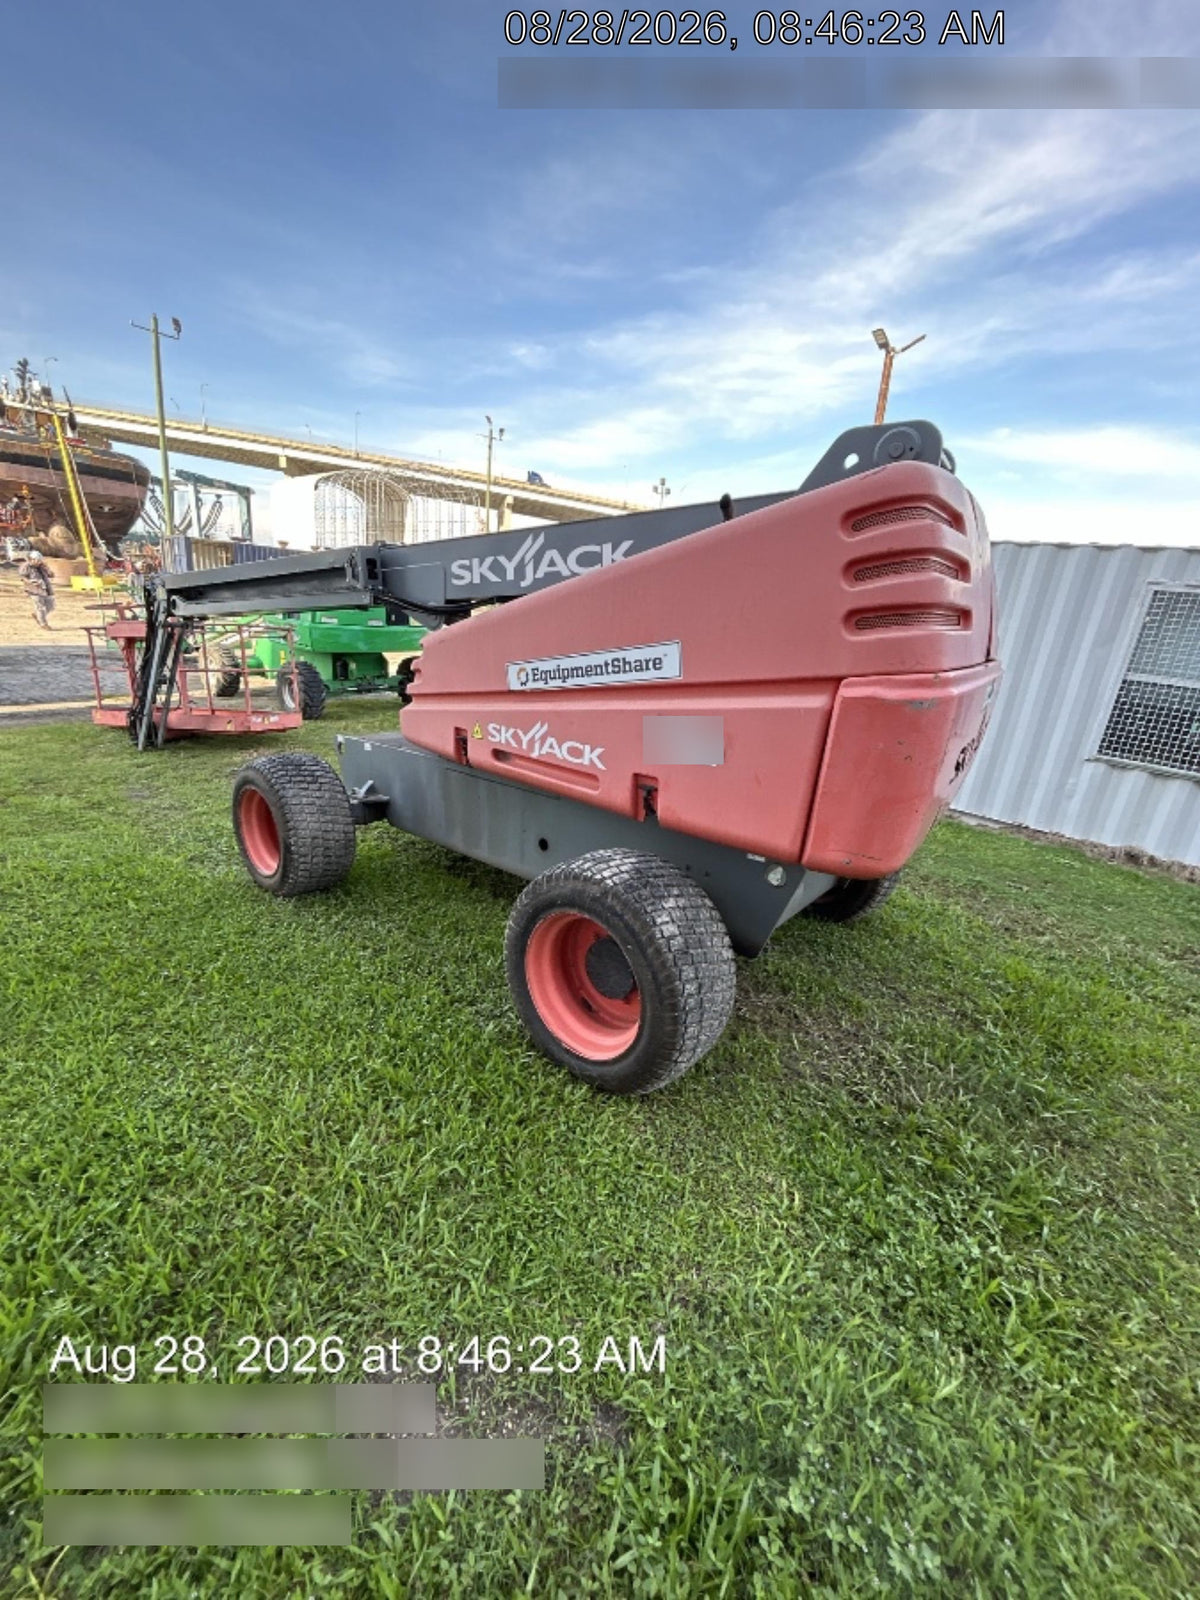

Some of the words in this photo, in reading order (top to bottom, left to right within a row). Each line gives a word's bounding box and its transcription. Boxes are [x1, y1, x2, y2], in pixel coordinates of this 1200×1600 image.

[451, 531, 635, 588] SKYJACK
[531, 656, 664, 685] EquipmentShare
[487, 720, 607, 771] SKYJACK
